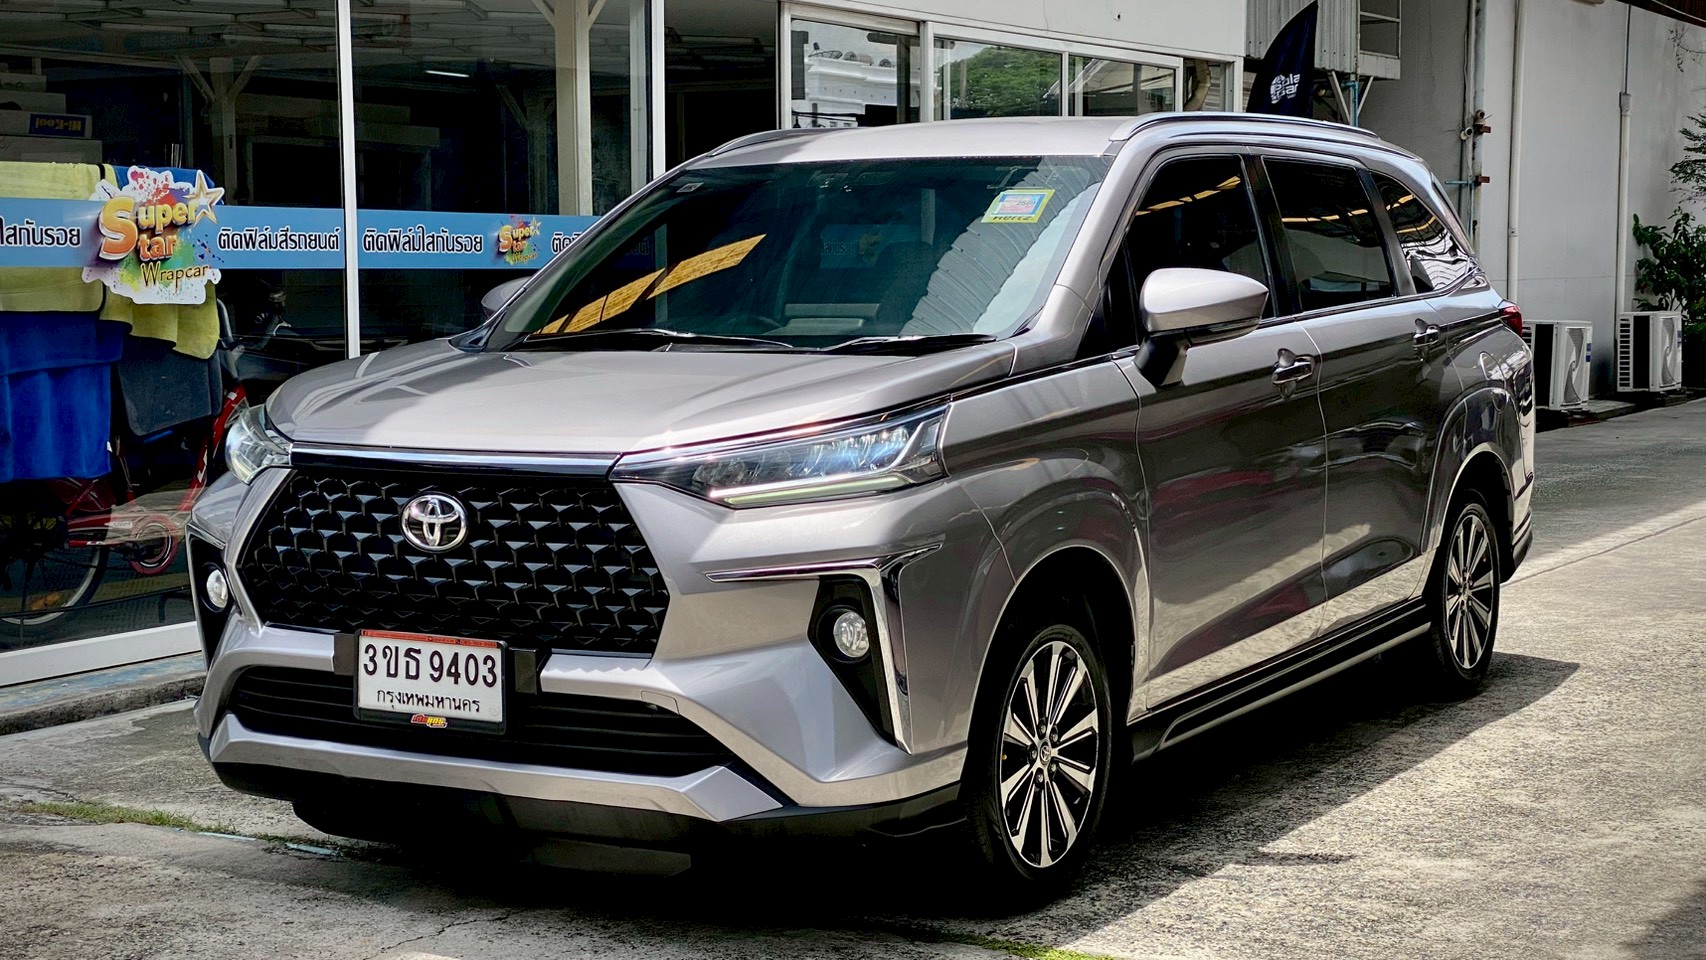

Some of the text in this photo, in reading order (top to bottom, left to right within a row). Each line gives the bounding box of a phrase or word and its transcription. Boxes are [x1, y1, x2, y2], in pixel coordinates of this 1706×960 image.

[99, 196, 197, 259] Super
[218, 226, 341, 250] ติดฟิล์มสีรถยนต์
[363, 225, 484, 253] ติดฟิล์มใสกันรอย
[499, 225, 533, 252] Super
[141, 262, 208, 292] Wrapcar
[364, 643, 498, 688] 3ขธ 9403
[377, 689, 480, 713] กรุงเทพมหานคร
